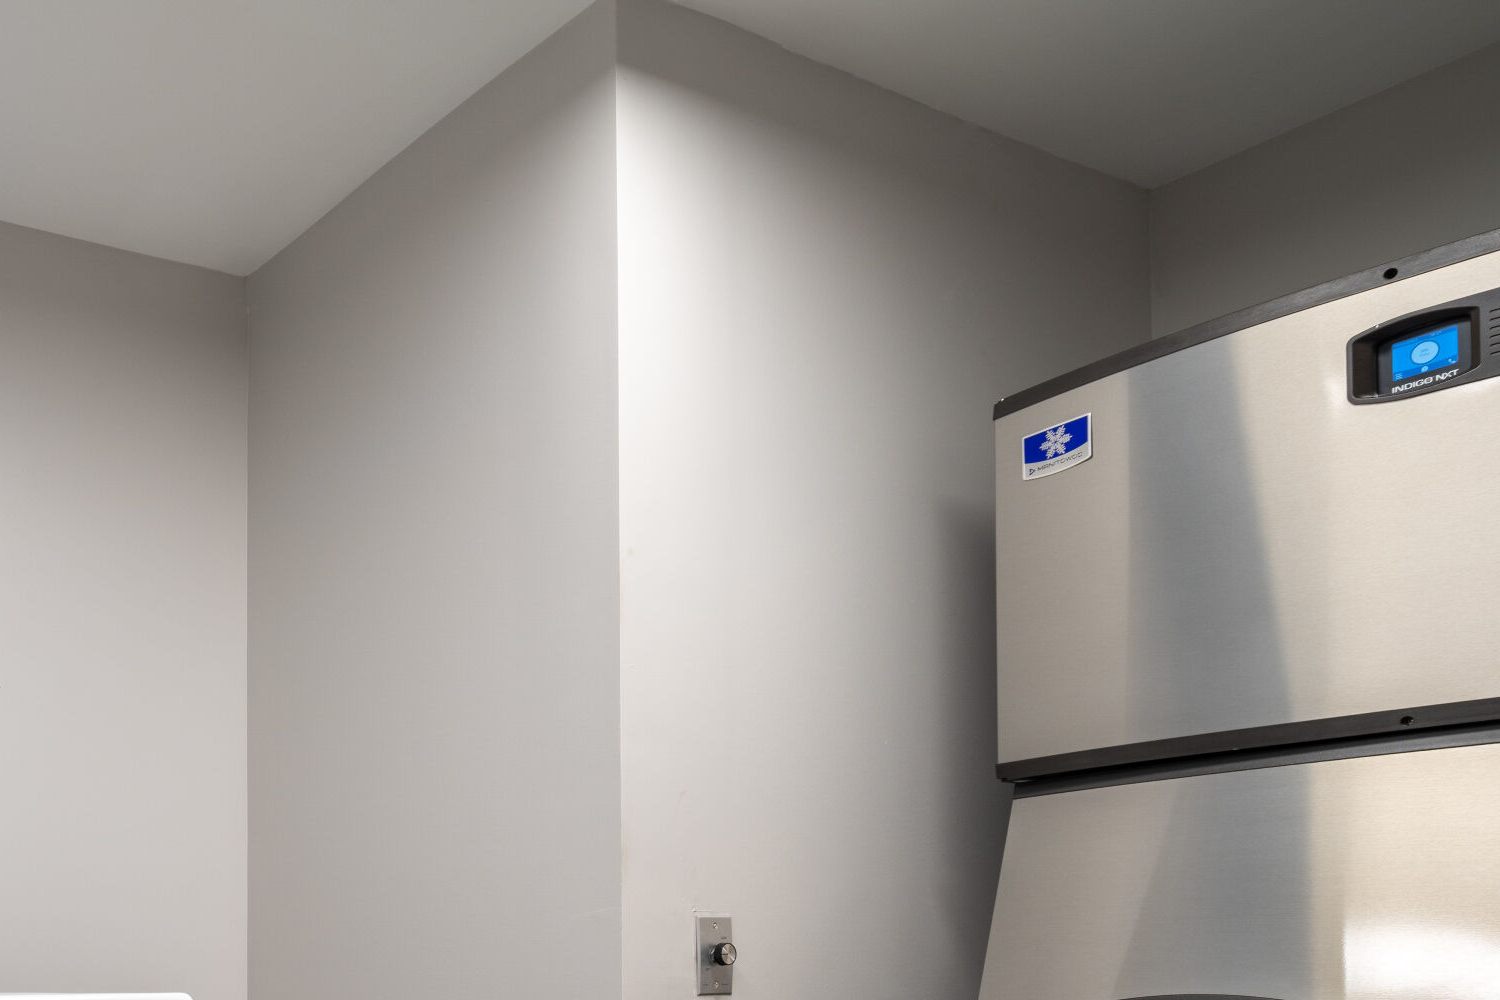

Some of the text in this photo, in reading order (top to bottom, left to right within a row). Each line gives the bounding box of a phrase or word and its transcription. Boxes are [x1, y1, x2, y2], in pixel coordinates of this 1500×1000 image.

[1392, 369, 1459, 393] INDIGO NXT
[1037, 452, 1083, 471] MANITOWOC
